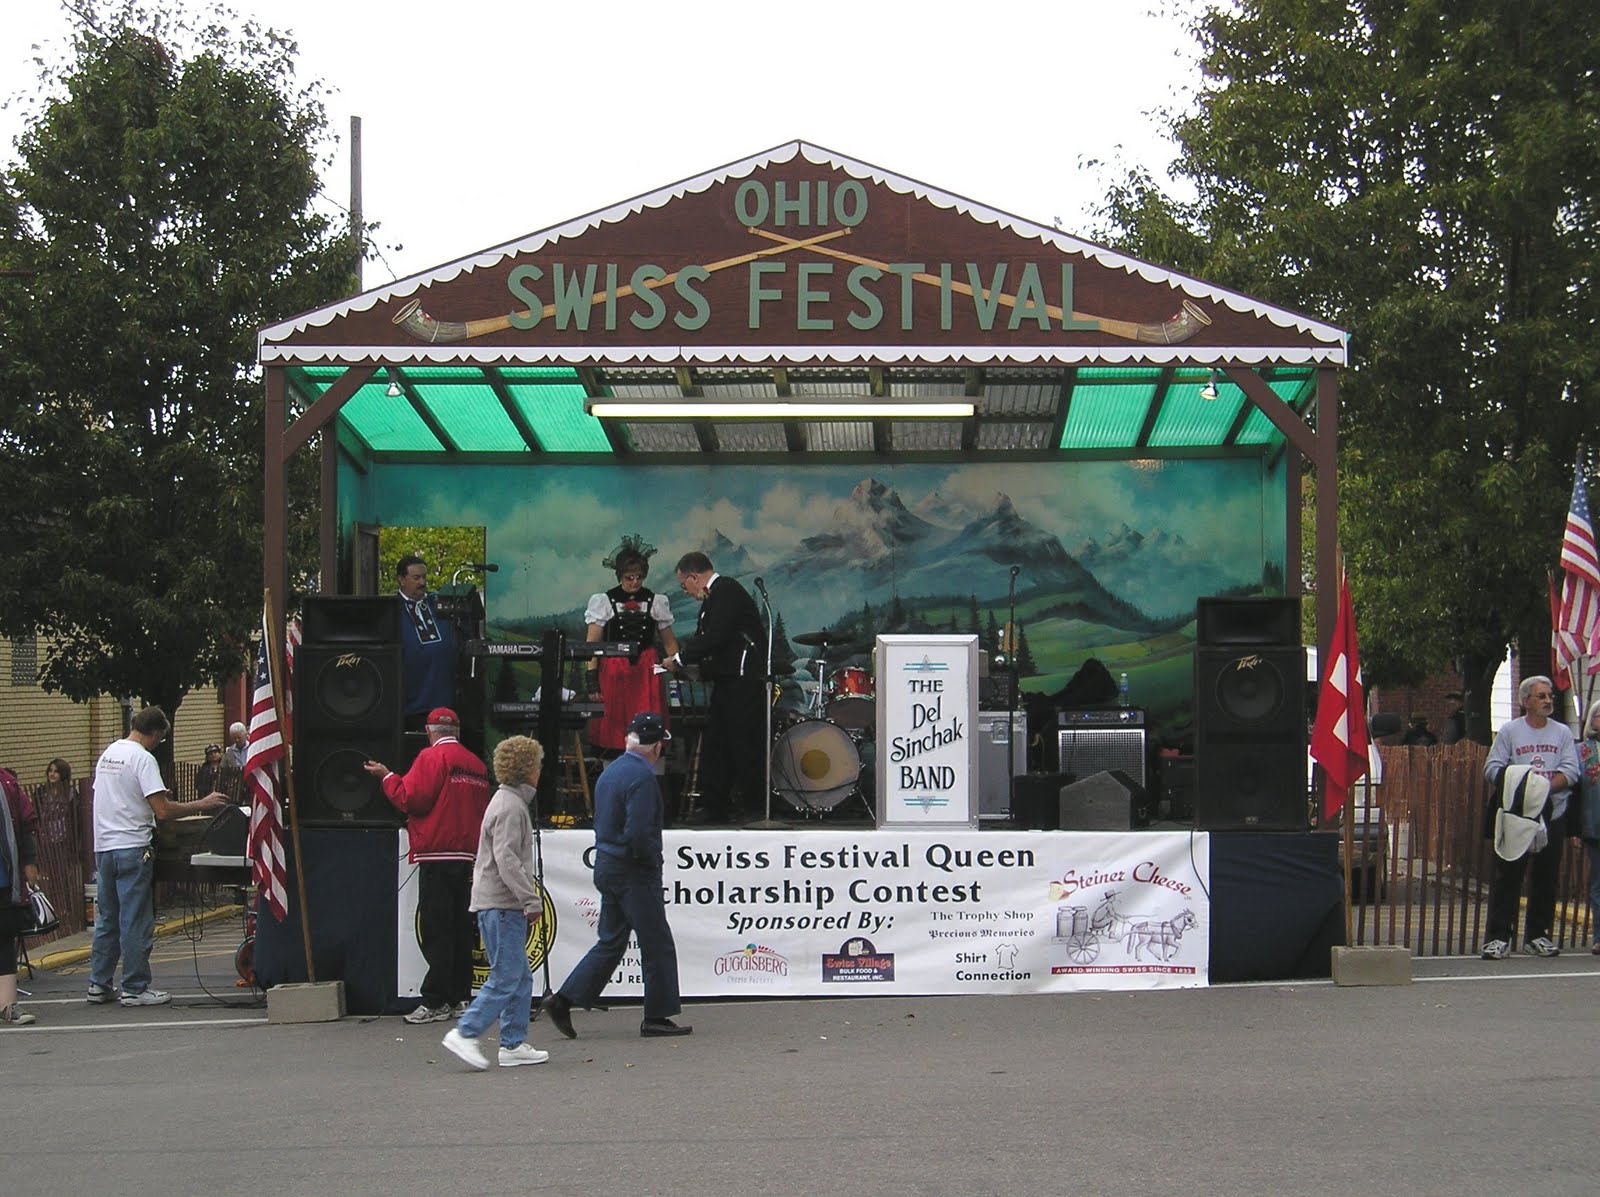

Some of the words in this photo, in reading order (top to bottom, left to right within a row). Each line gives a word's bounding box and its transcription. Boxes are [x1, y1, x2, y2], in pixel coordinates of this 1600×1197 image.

[735, 180, 868, 227] OHIO
[507, 263, 711, 330] SWISS
[749, 262, 1101, 330] FESTIVAL
[488, 645, 518, 654] YAMAHA
[908, 680, 944, 693] THE
[912, 695, 942, 730] Del
[890, 716, 964, 763] Sinchak
[1515, 745, 1535, 756] OHIO
[1536, 744, 1559, 754] STATE
[900, 765, 956, 790] BAND
[677, 845, 770, 870] Swiss
[783, 843, 911, 870] Festival
[925, 844, 1036, 872] Queen
[1062, 869, 1126, 894] Steiner
[1132, 861, 1192, 896] Cheese
[660, 880, 834, 910] cholarship
[848, 880, 982, 903] Contest
[726, 911, 851, 935] Sponsored
[857, 911, 896, 934] By:
[930, 911, 954, 921] The
[956, 911, 1000, 923] Trophy
[1004, 910, 1034, 922] Shop
[928, 929, 978, 940] Precious
[979, 928, 1036, 938] Memories
[714, 955, 788, 977] GUGGISBERG
[826, 958, 855, 969] Swiss
[856, 957, 892, 970] Village
[955, 953, 988, 963] Shirt
[839, 968, 856, 976] BULK
[956, 970, 1032, 981] Connection
